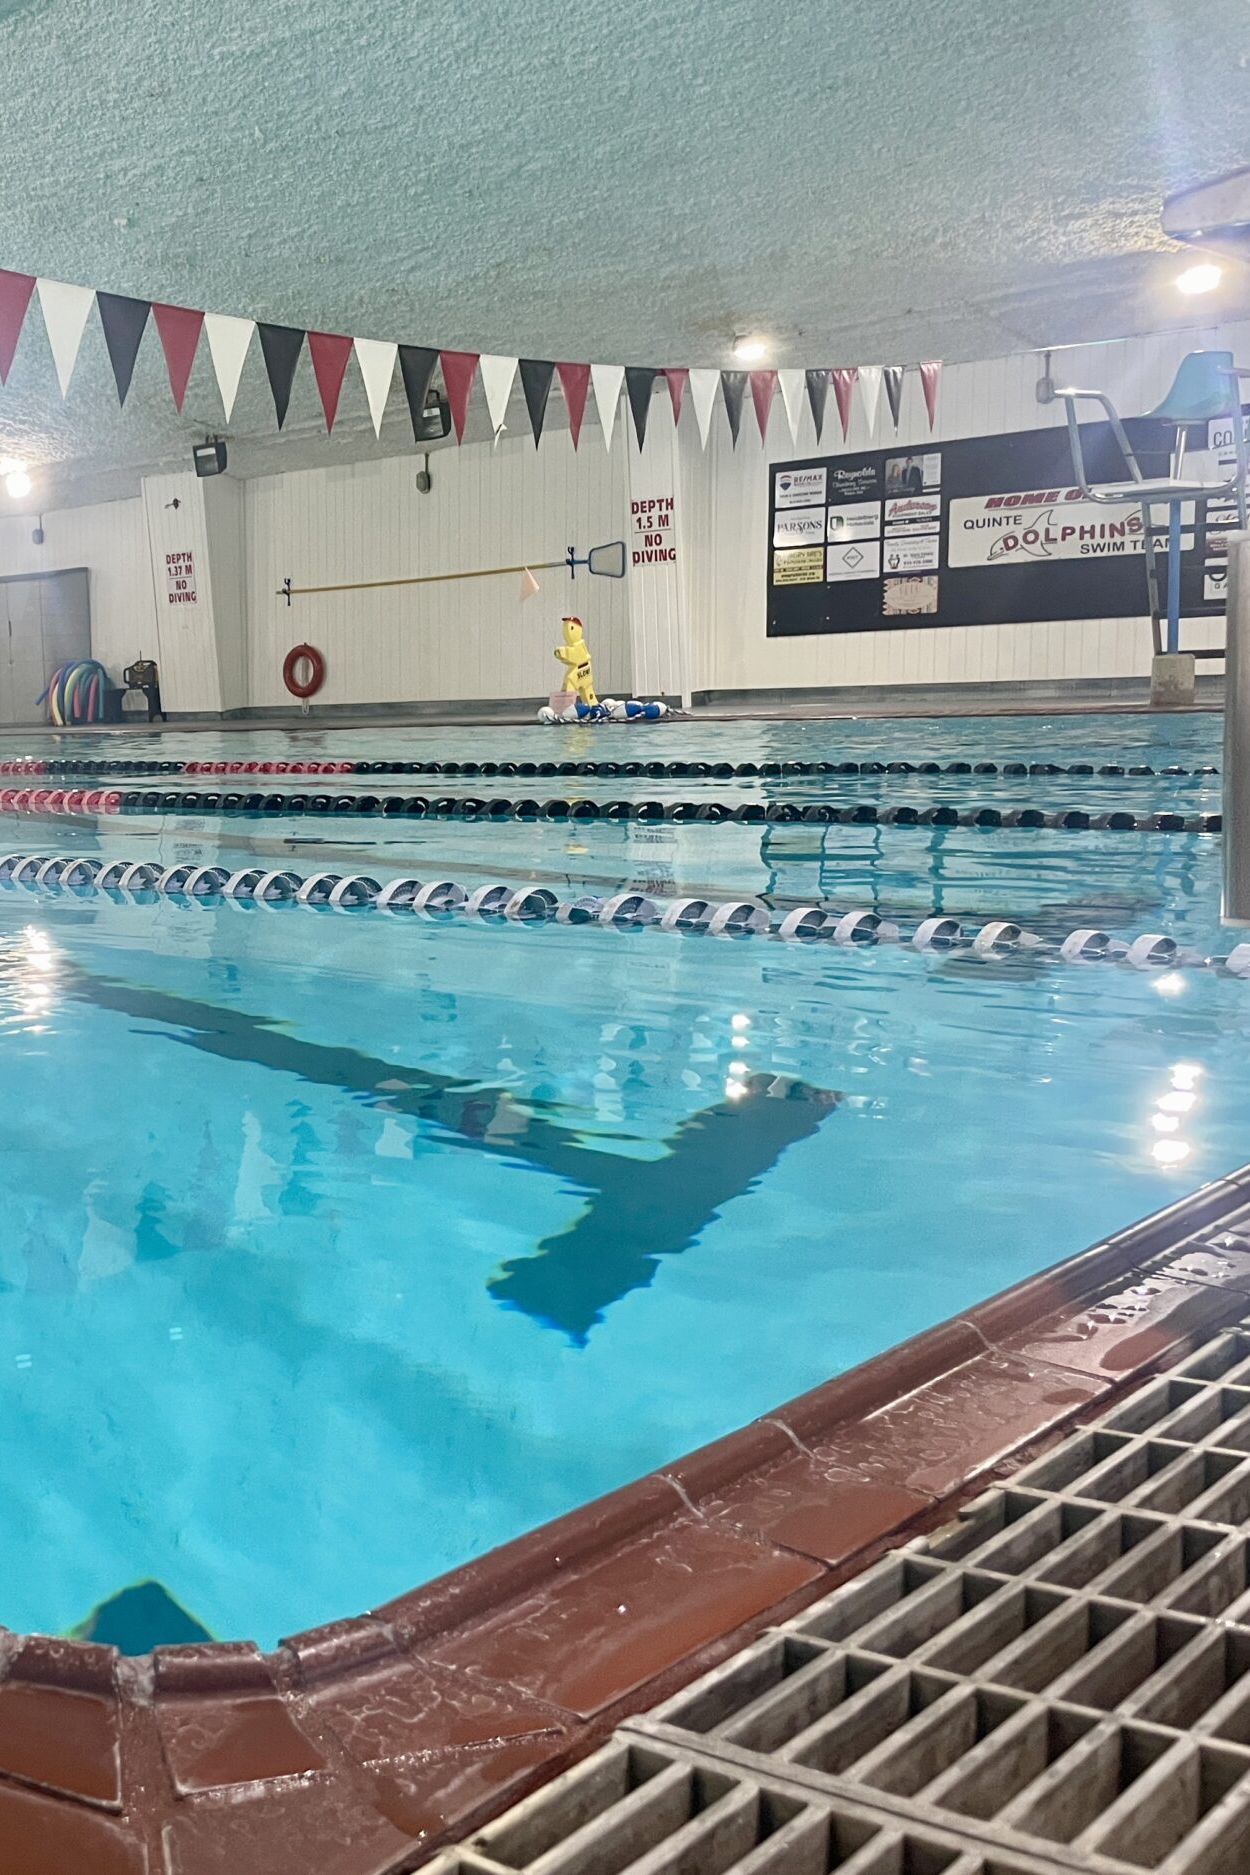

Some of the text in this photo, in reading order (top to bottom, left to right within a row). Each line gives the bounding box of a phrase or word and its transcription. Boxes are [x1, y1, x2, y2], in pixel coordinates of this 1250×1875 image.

[631, 497, 674, 515] DEPTH
[984, 490, 1061, 510] HOME
[636, 513, 669, 530] 1.5 M
[963, 514, 1023, 530] QUINTE
[644, 533, 662, 548] NO
[1002, 516, 1144, 552] DOLPHINS
[1080, 541, 1125, 555] SWIM
[166, 551, 193, 565] DEPTH
[632, 548, 676, 564] DIVING
[168, 564, 193, 577] 1.37 M
[175, 579, 187, 591] NO
[168, 591, 197, 604] DIVING
